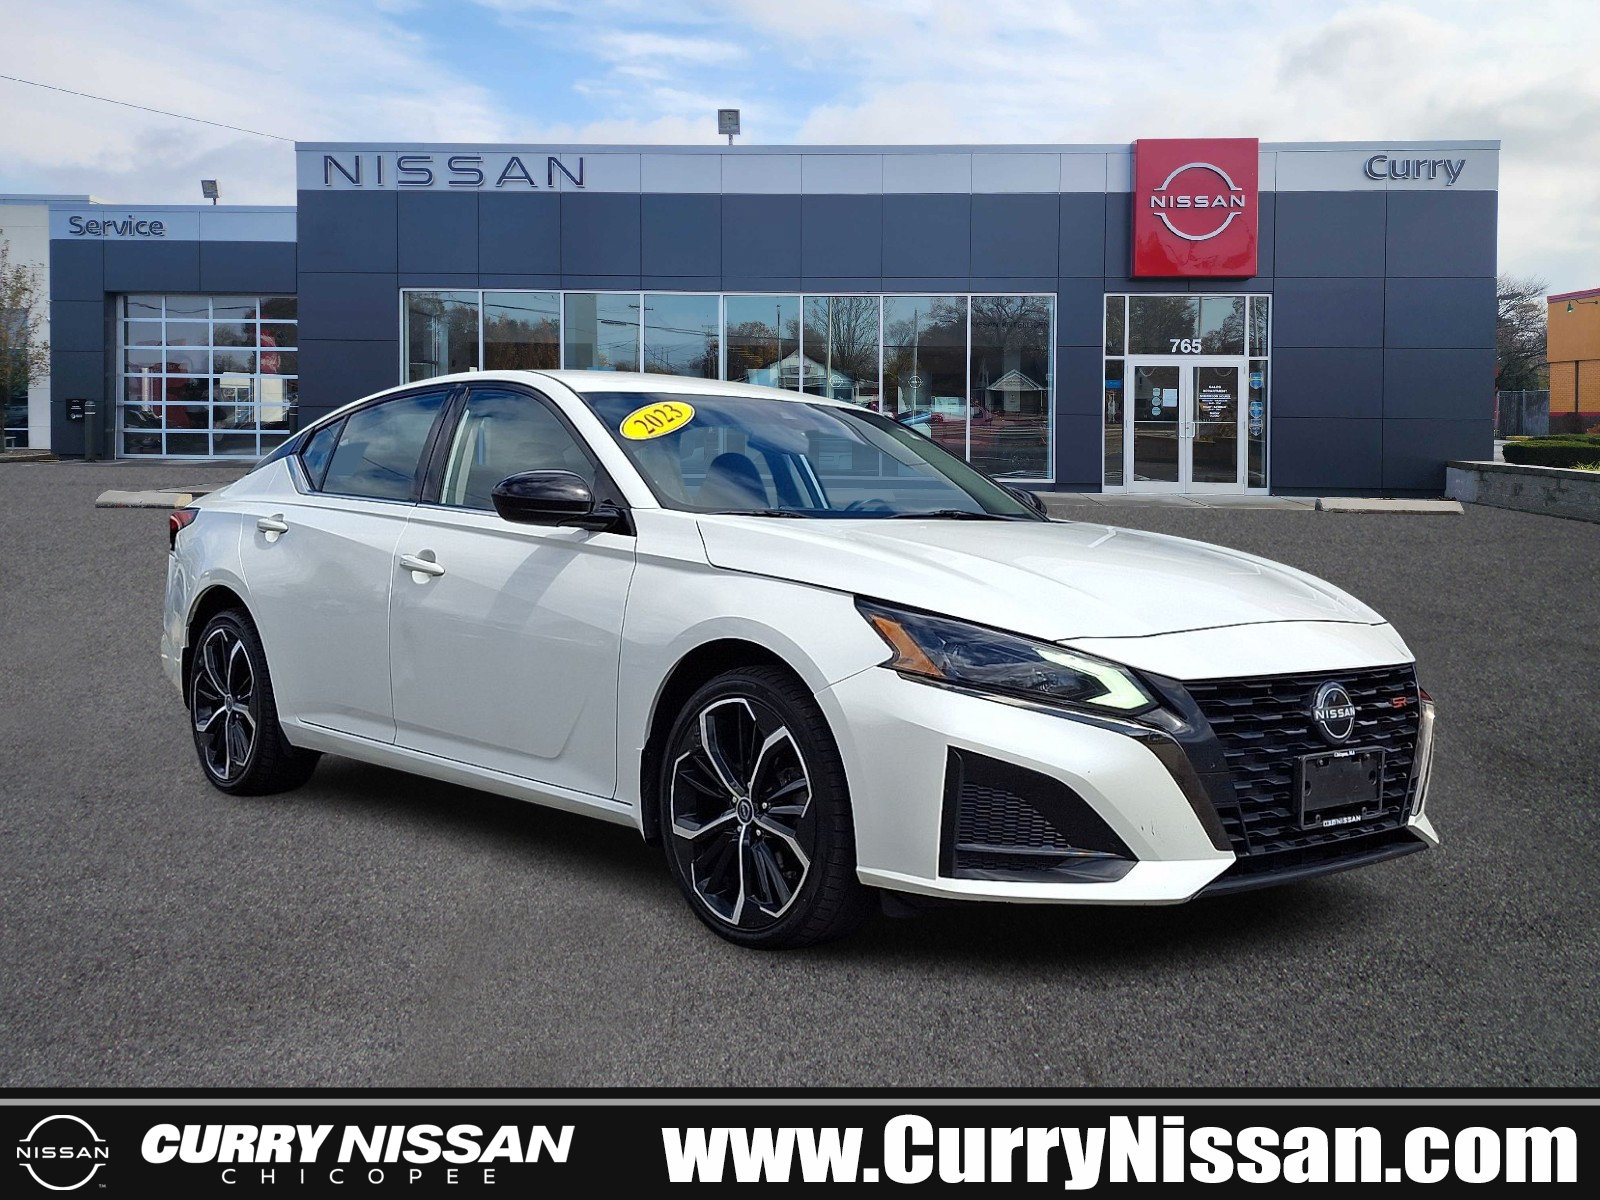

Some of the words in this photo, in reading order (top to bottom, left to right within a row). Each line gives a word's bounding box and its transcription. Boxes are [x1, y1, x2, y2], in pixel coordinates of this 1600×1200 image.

[323, 156, 586, 188] NISSAN
[1364, 154, 1466, 186] Curry
[1151, 194, 1246, 209] NISSAN
[68, 215, 164, 238] Service
[1170, 338, 1203, 354] 765
[634, 404, 683, 434] 2023
[1315, 706, 1355, 719] NISSAN
